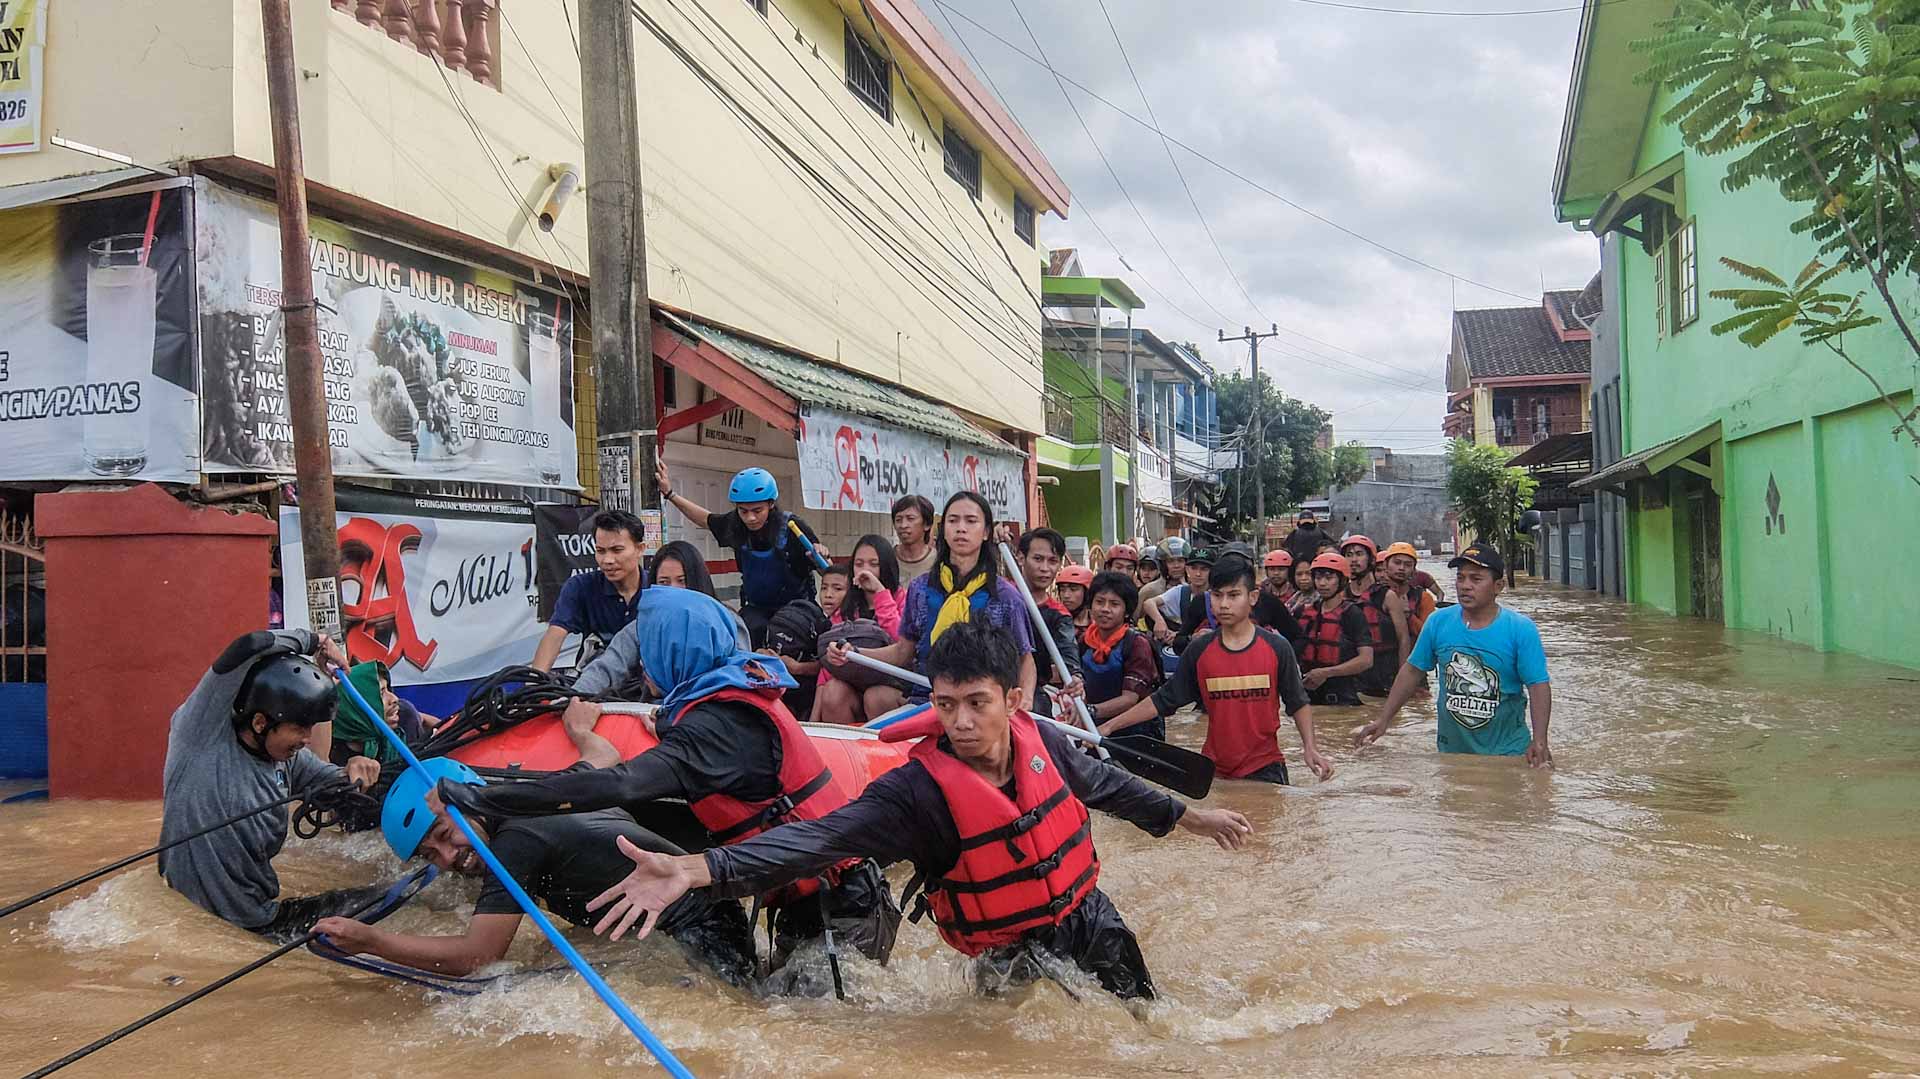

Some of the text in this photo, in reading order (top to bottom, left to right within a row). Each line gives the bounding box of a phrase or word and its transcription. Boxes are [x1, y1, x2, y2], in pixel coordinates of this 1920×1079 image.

[409, 267, 456, 307] NUR
[449, 331, 497, 356] MINUMAN
[322, 355, 353, 377] ASA
[459, 358, 511, 383] JUS JERUK
[459, 381, 526, 406] JUS ALPOKAT
[460, 402, 498, 422] POP ICE
[460, 422, 549, 448] TEH DINGIN/PANAS
[558, 533, 597, 557] TOK
[430, 551, 515, 617] Mild
